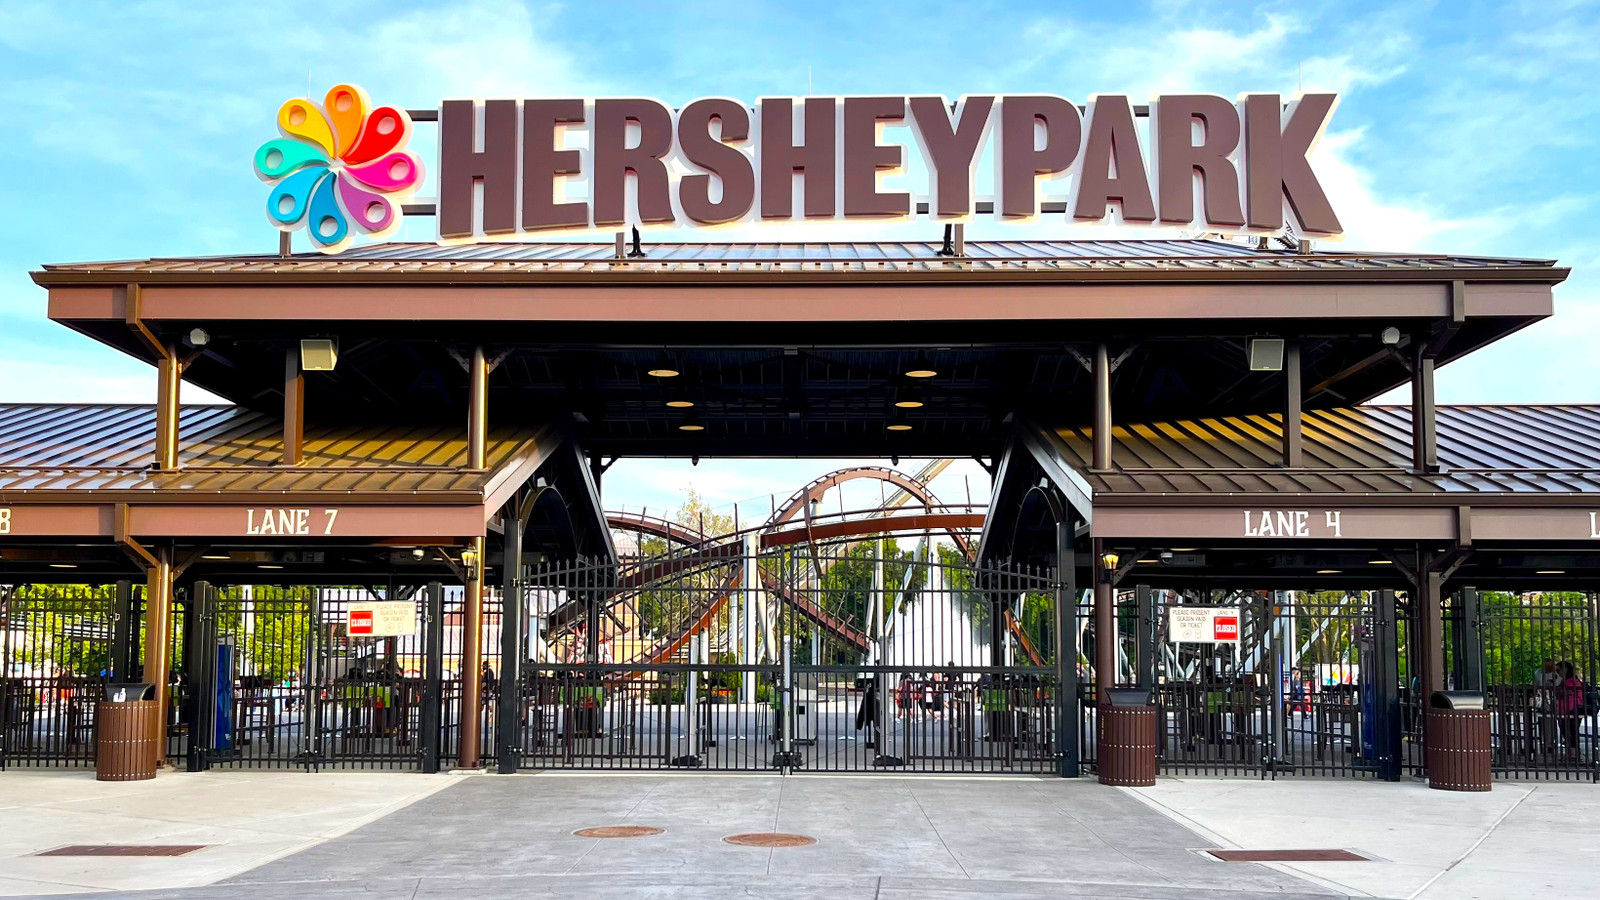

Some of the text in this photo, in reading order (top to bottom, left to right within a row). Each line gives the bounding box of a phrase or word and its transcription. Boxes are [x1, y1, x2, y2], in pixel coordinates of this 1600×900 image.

[440, 93, 1344, 238] HERSHEYPARK
[0, 508, 11, 534] 8
[246, 509, 339, 535] LANE 7
[1243, 510, 1342, 537] LANE 4
[351, 618, 372, 627] CLOSED
